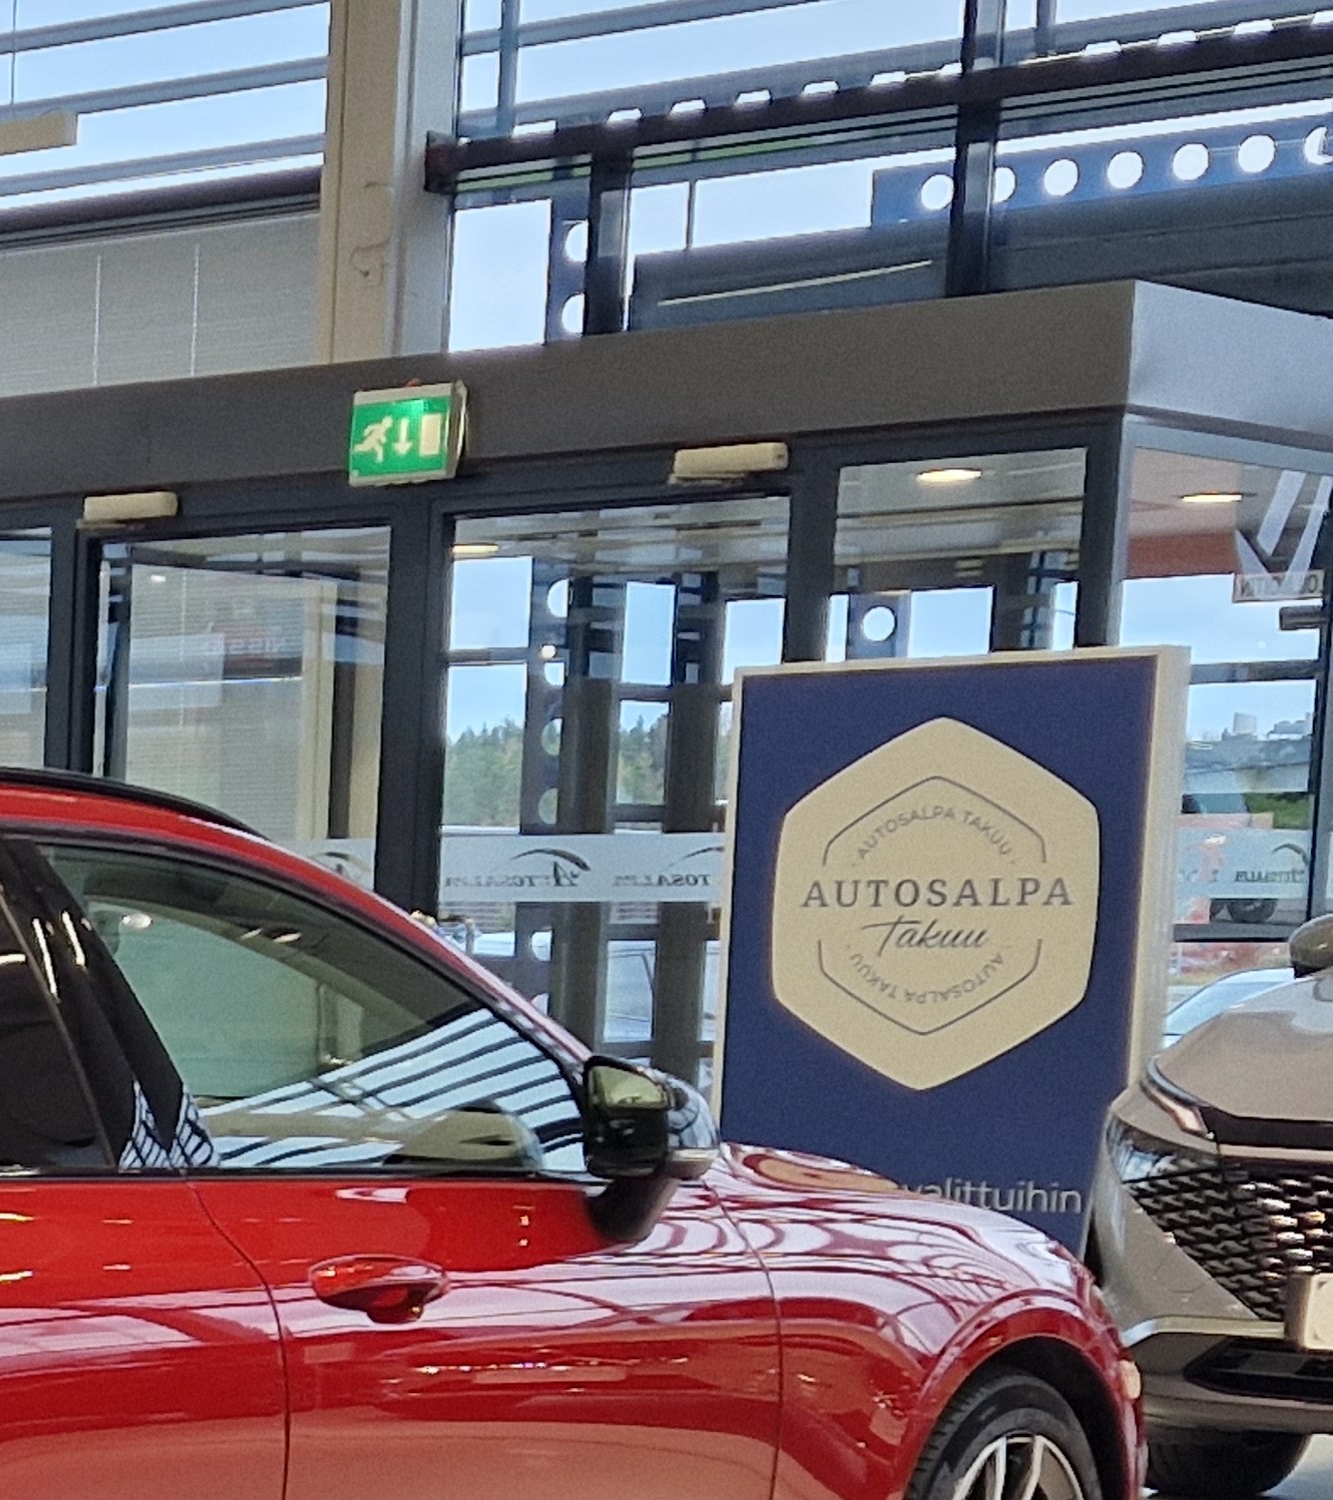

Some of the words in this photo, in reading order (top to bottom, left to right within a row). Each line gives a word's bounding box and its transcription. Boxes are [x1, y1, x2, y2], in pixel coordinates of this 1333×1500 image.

[858, 805, 956, 859] AUTOSALPA
[962, 809, 1013, 855] TAKUU
[800, 876, 1074, 908] AUTOSALPA
[861, 915, 988, 957] Takuu
[848, 953, 903, 997] TAKUU
[904, 952, 1006, 1005] AUTOSALPA
